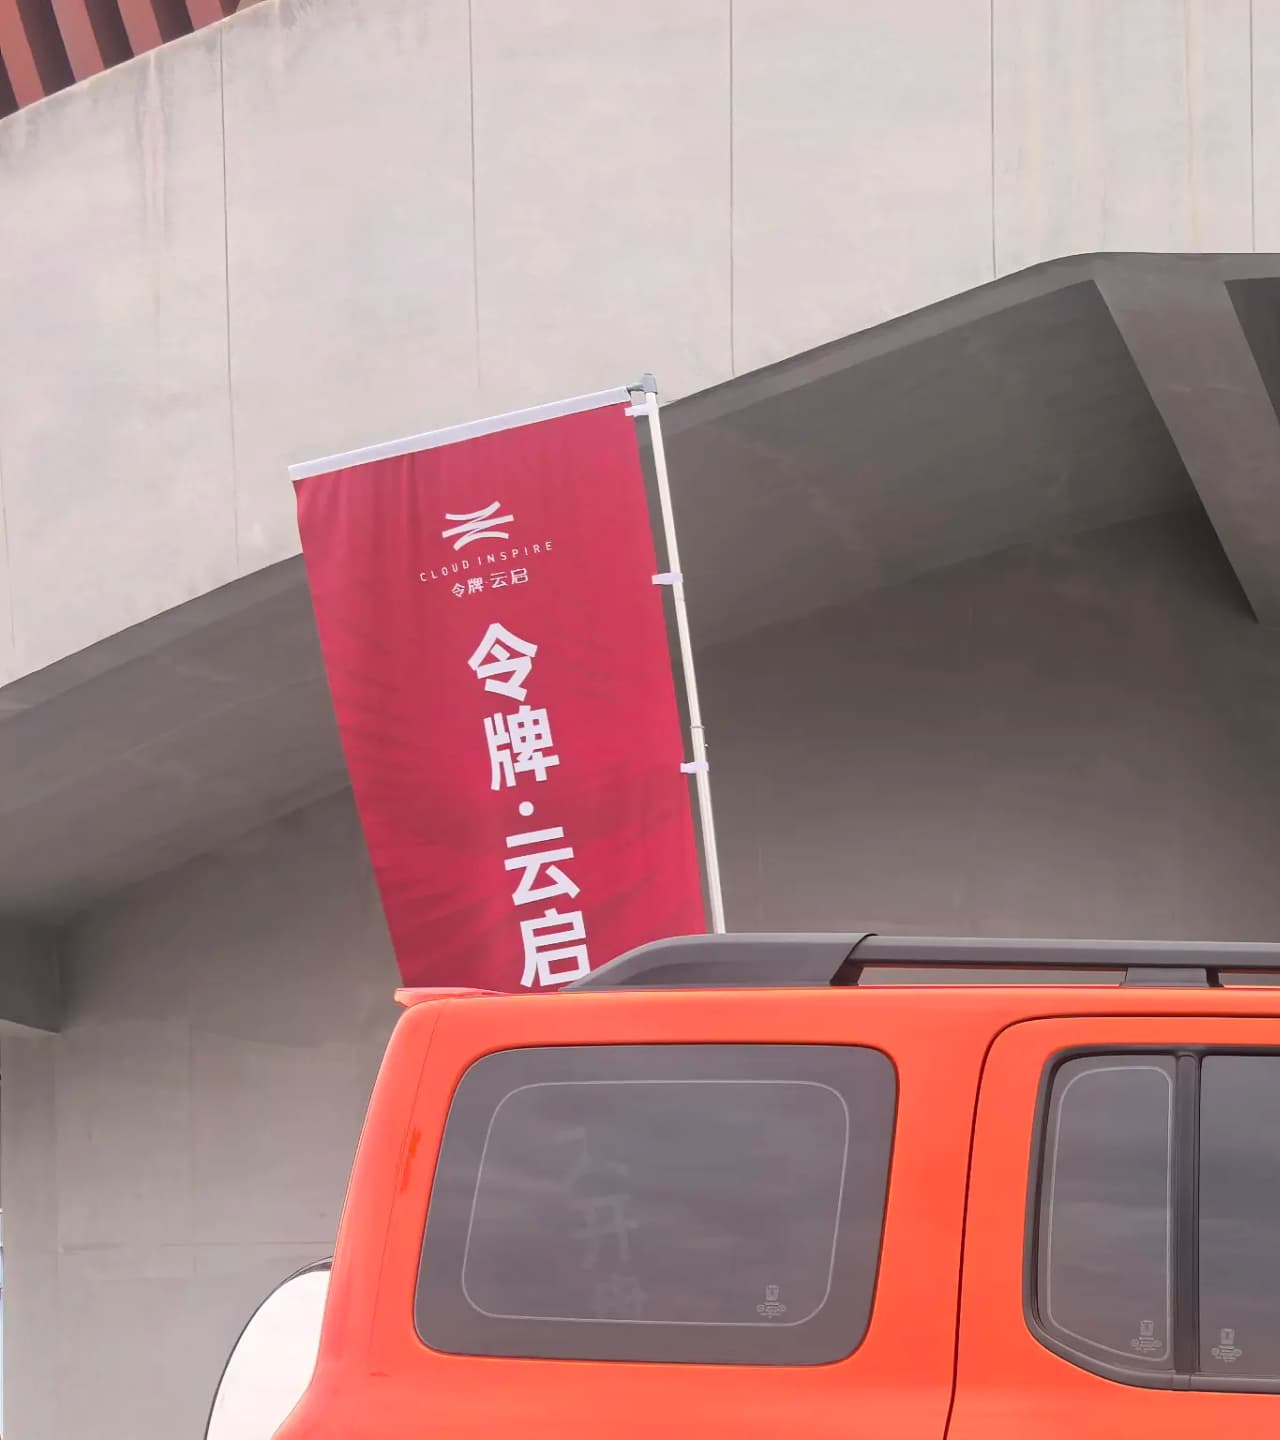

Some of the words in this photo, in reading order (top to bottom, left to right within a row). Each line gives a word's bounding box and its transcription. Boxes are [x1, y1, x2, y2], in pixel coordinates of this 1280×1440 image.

[419, 560, 470, 583] CLOUD
[476, 541, 553, 566] INSPIRE
[467, 622, 592, 989] 令牌·云启
